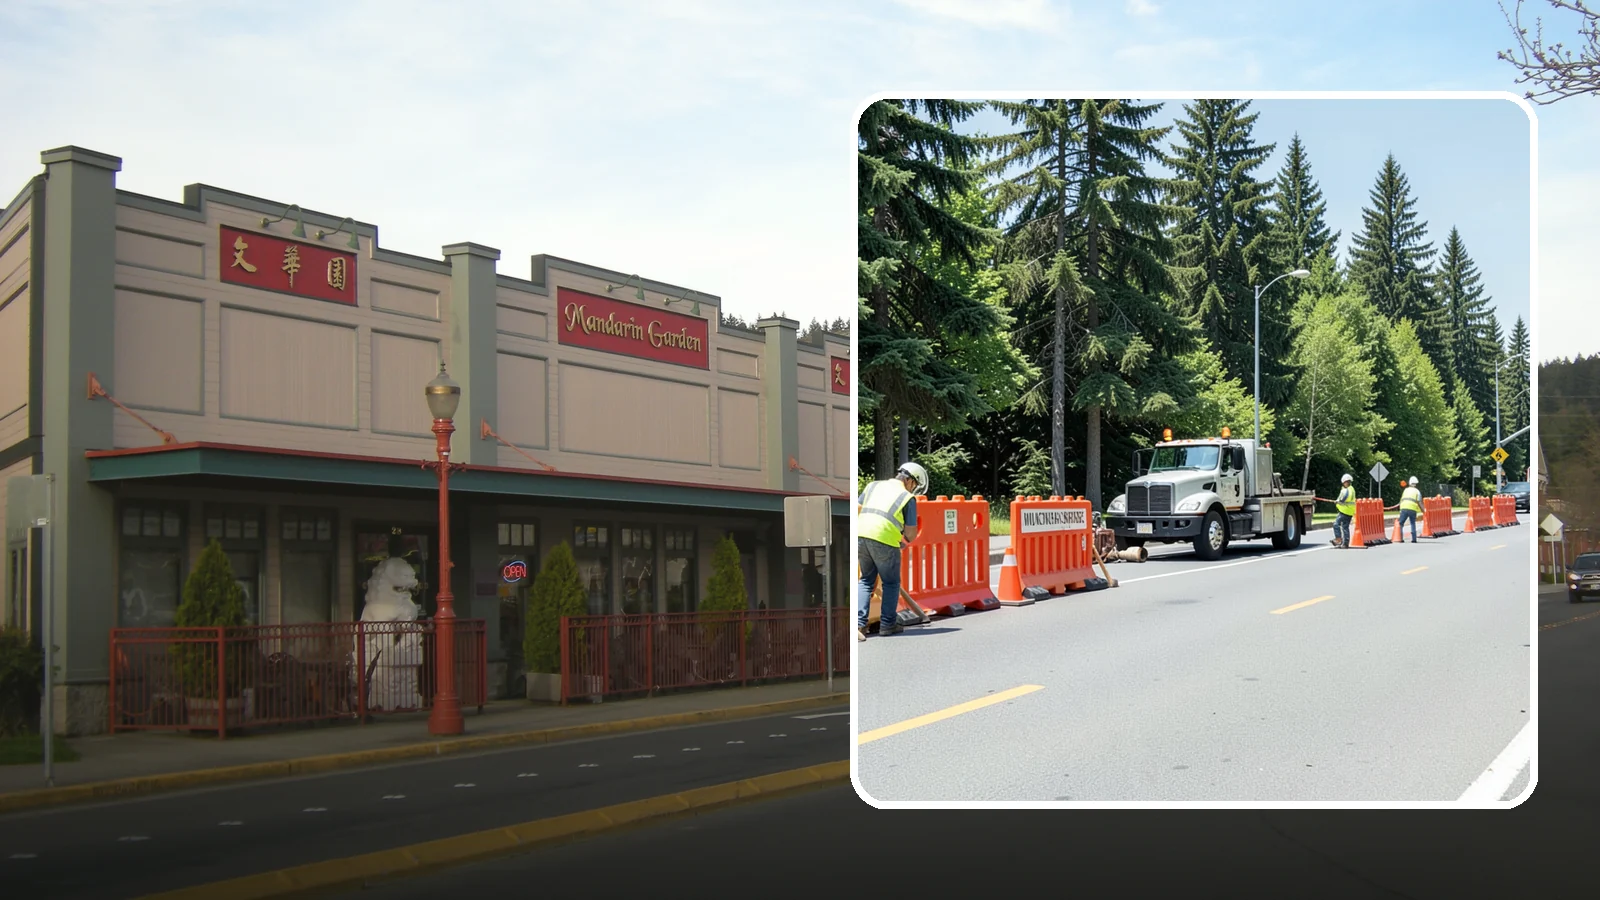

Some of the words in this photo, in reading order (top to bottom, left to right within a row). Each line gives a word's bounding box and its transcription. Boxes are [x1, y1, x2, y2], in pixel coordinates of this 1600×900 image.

[564, 302, 644, 341] Mandarin
[648, 320, 702, 352] Garden
[503, 565, 527, 578] OPEN
